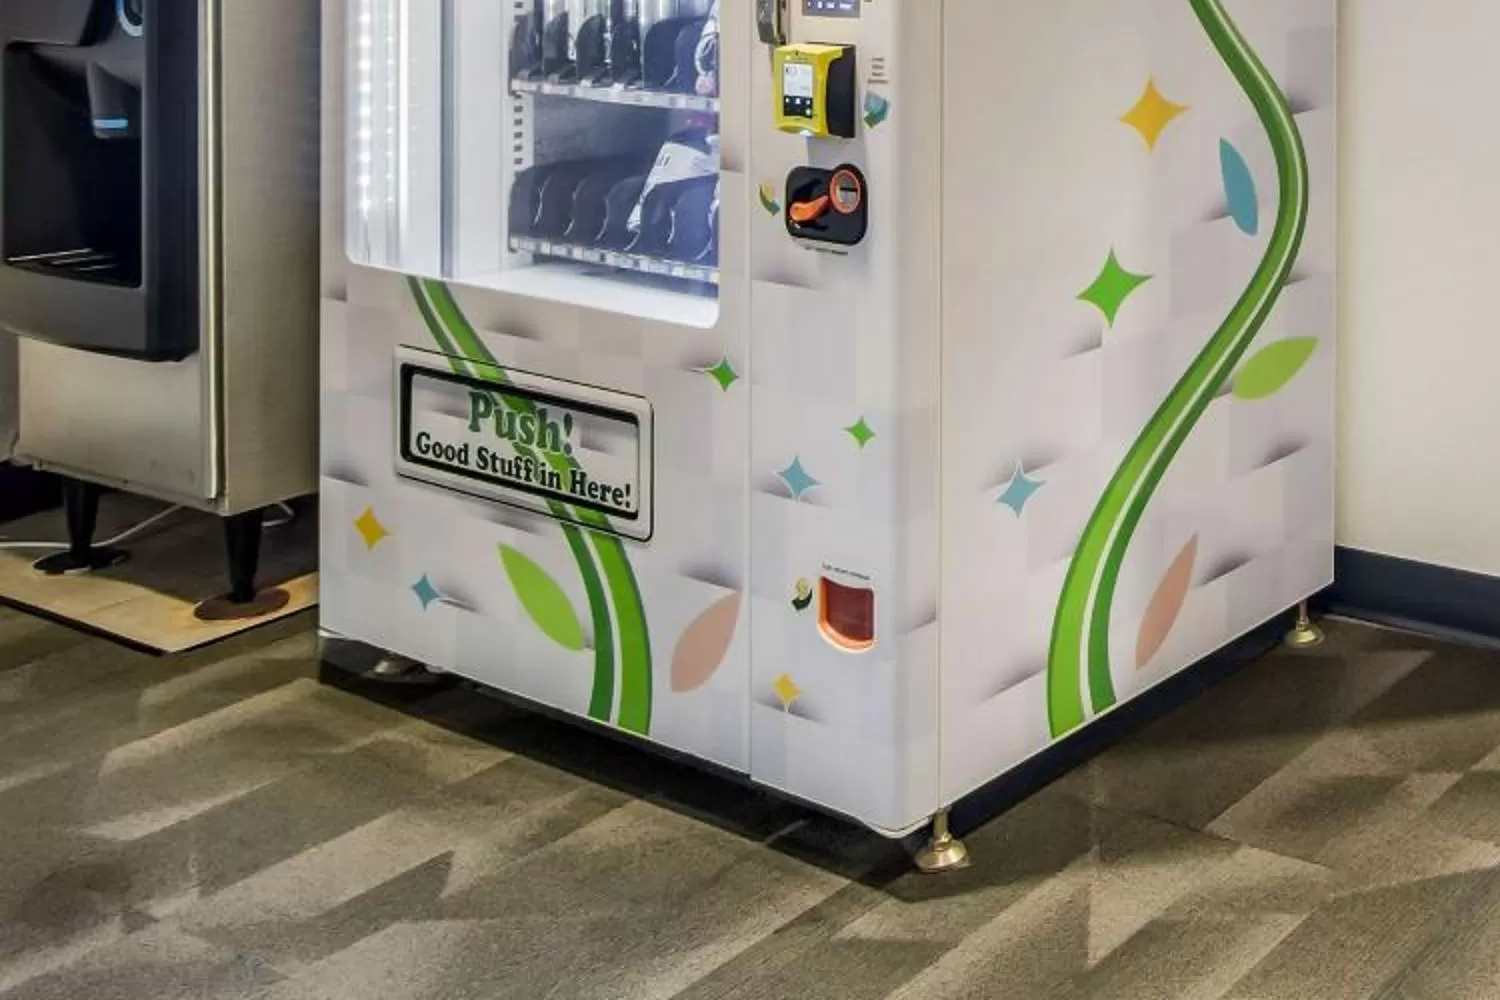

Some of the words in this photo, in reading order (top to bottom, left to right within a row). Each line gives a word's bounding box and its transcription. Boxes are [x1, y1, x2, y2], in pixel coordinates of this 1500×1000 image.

[468, 391, 573, 456] Push!
[415, 431, 469, 467] Good
[475, 446, 536, 483] Stuff
[540, 463, 563, 490] in
[570, 468, 632, 509] Here!
